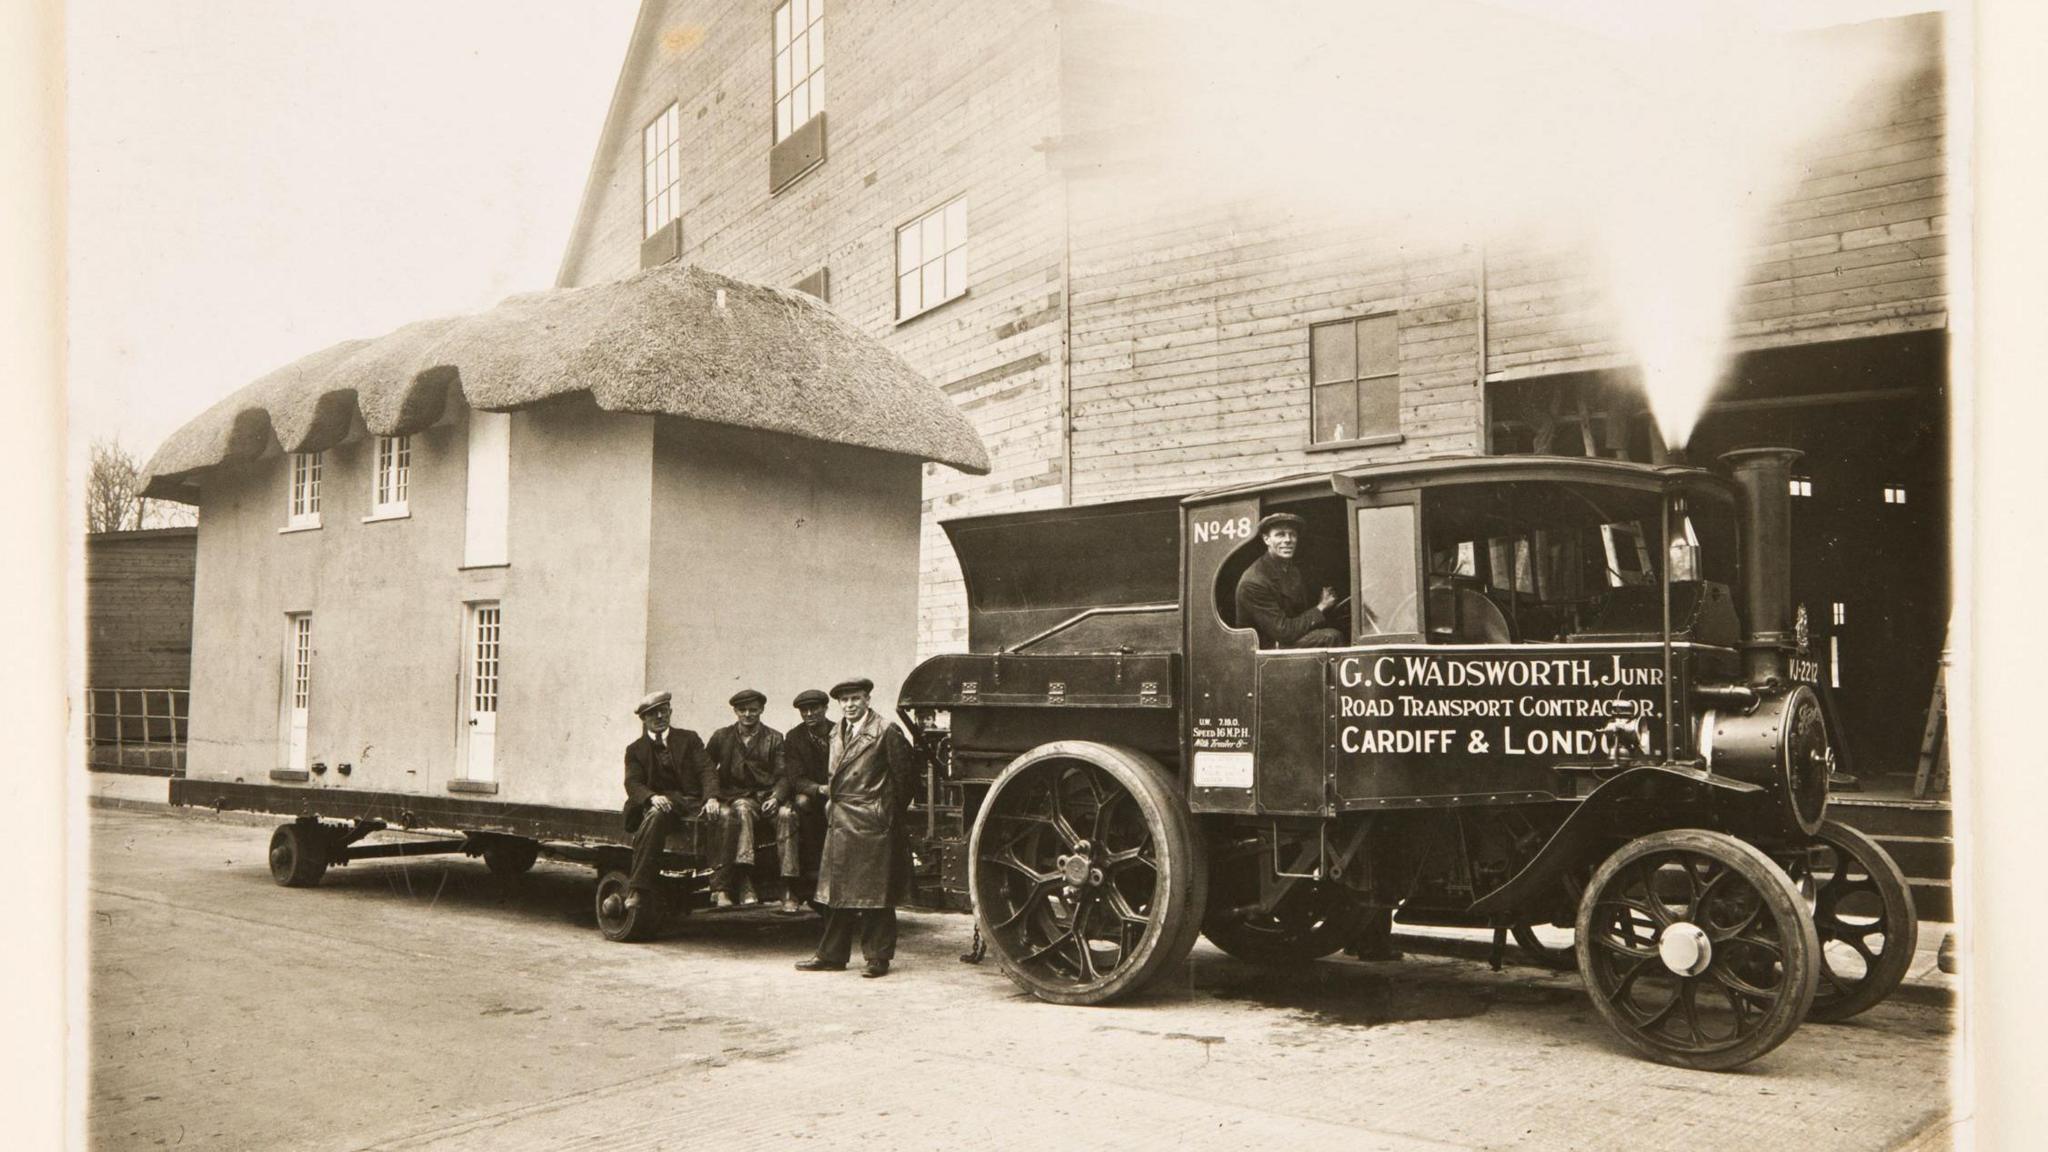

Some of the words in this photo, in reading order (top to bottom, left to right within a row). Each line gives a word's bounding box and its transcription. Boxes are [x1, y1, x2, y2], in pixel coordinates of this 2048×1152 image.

[1340, 695, 1395, 717] ROAD
[1398, 695, 1514, 717] TRANSPORT
[1519, 695, 1663, 718] CONTRACOR.
[1341, 725, 1457, 753] CARDIFF
[1467, 730, 1490, 754] &
